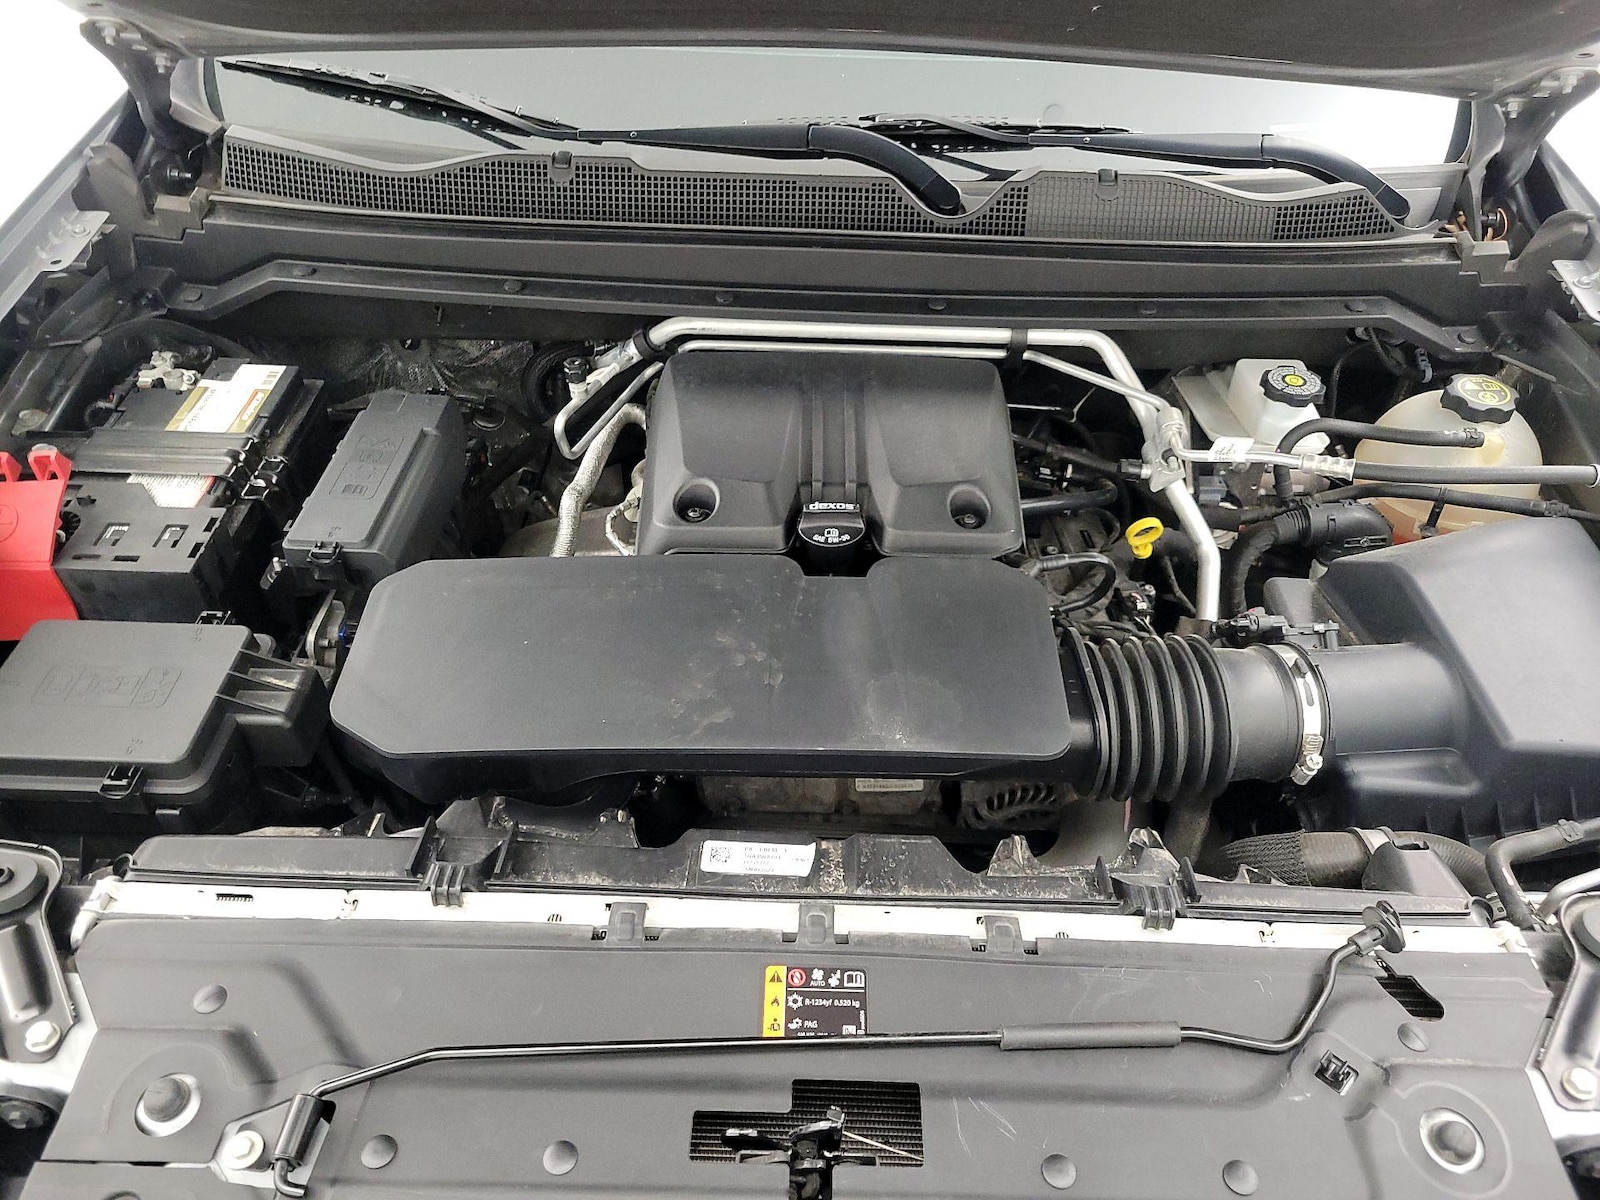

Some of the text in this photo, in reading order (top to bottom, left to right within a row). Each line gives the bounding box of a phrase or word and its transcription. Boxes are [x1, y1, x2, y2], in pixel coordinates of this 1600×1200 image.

[809, 501, 855, 510] dexos
[812, 534, 826, 543] SAE
[804, 998, 860, 1008] R-1234yf 0.520 kg
[804, 1020, 818, 1029] PAG
